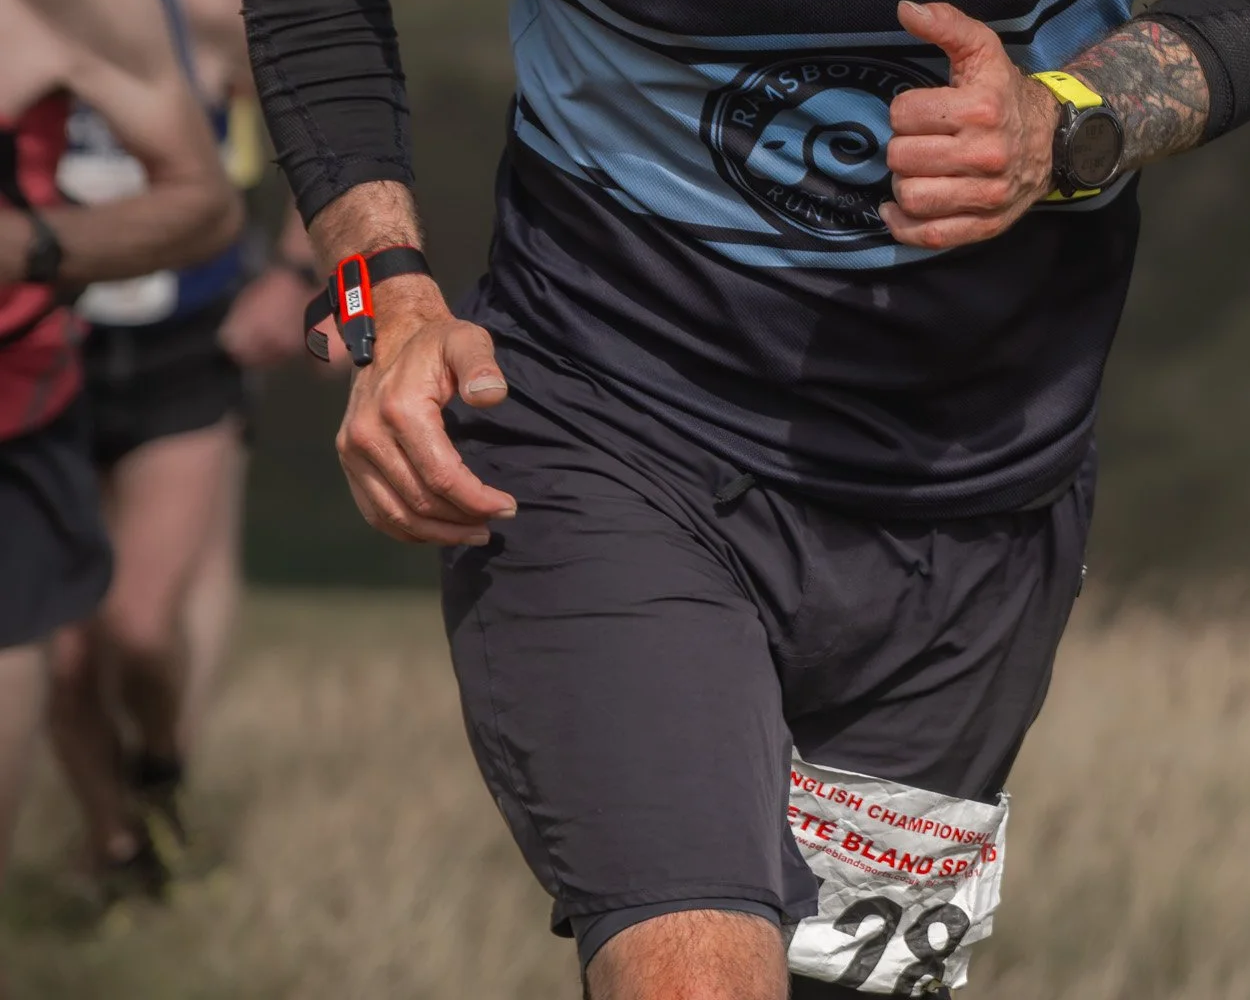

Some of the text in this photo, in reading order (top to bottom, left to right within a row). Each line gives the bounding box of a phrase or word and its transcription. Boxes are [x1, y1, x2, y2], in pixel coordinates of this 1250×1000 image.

[766, 185, 890, 225] RUNNIN
[790, 770, 864, 812] NGLISH
[787, 805, 838, 842] ETE
[841, 833, 933, 876] BLAND
